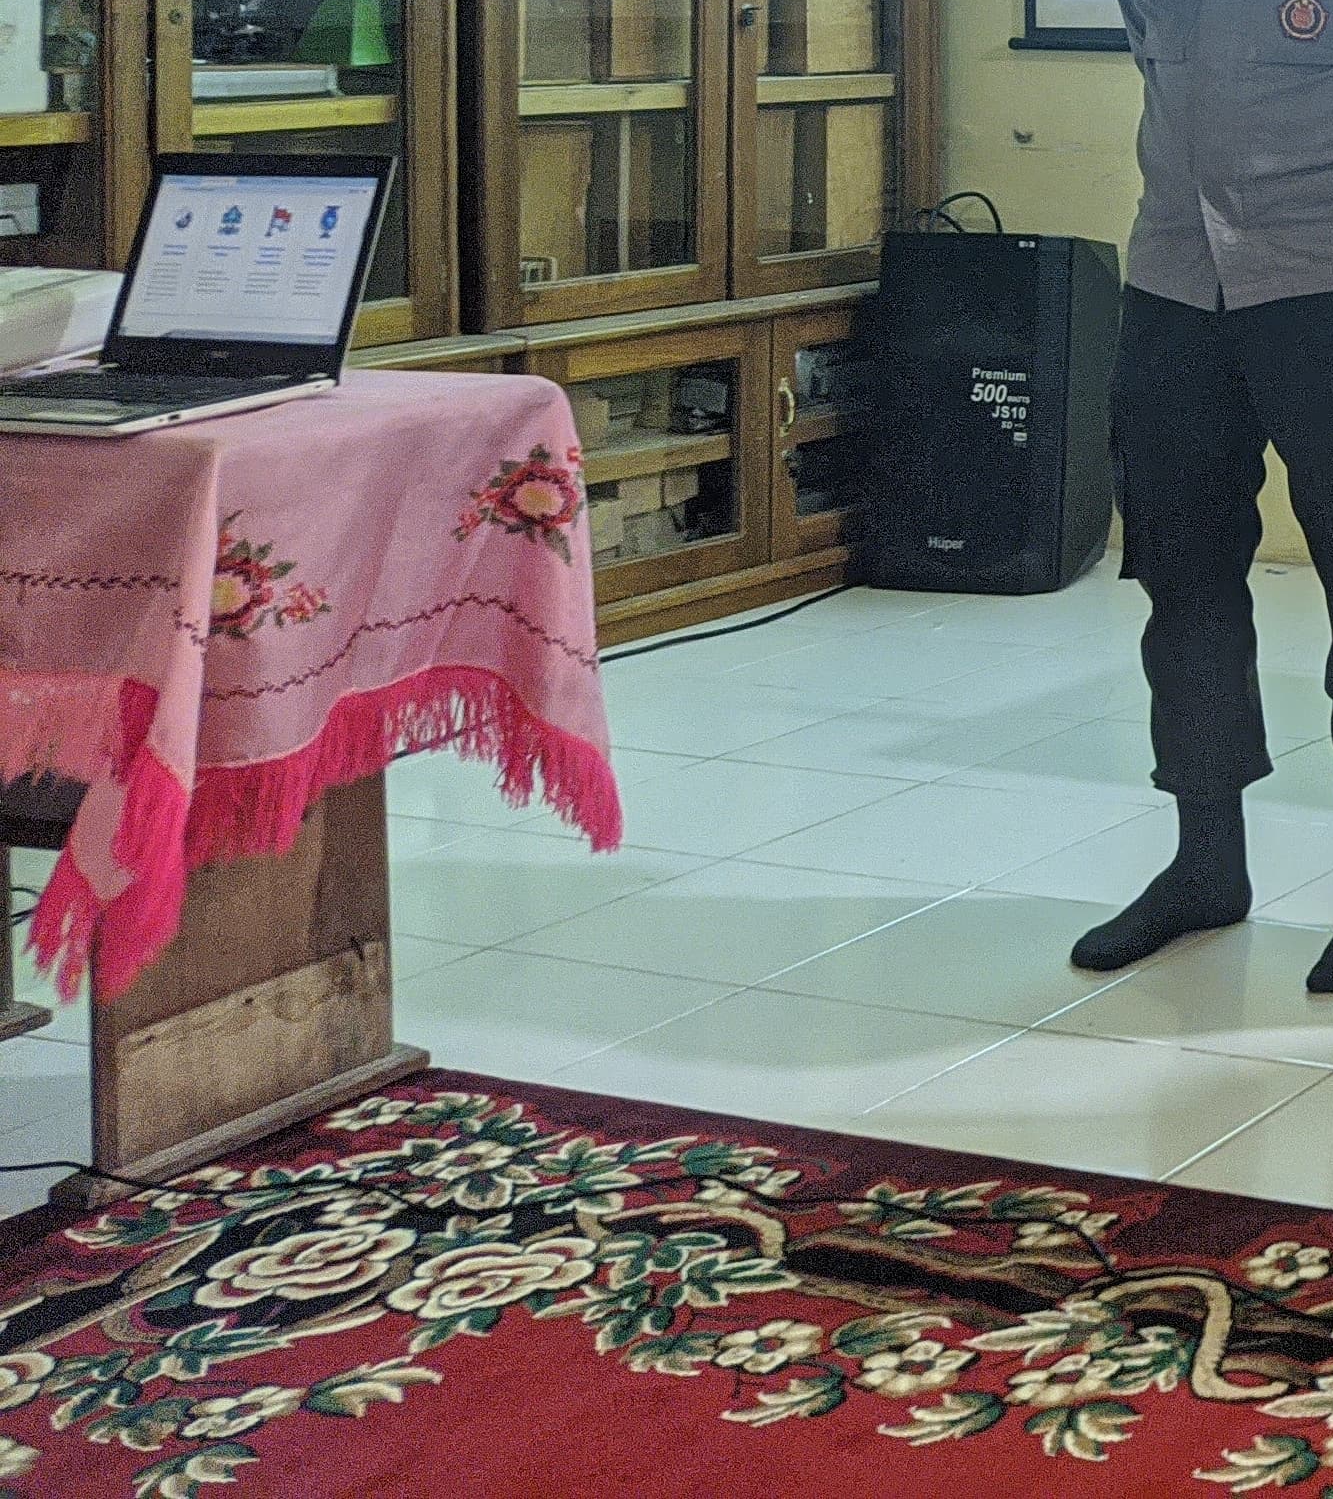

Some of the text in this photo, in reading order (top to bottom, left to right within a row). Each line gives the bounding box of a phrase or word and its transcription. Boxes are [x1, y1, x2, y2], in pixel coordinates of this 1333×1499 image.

[972, 367, 1027, 381] Premium
[970, 383, 1008, 403] 500
[991, 405, 1027, 420] JS10
[927, 536, 965, 552] Huper
